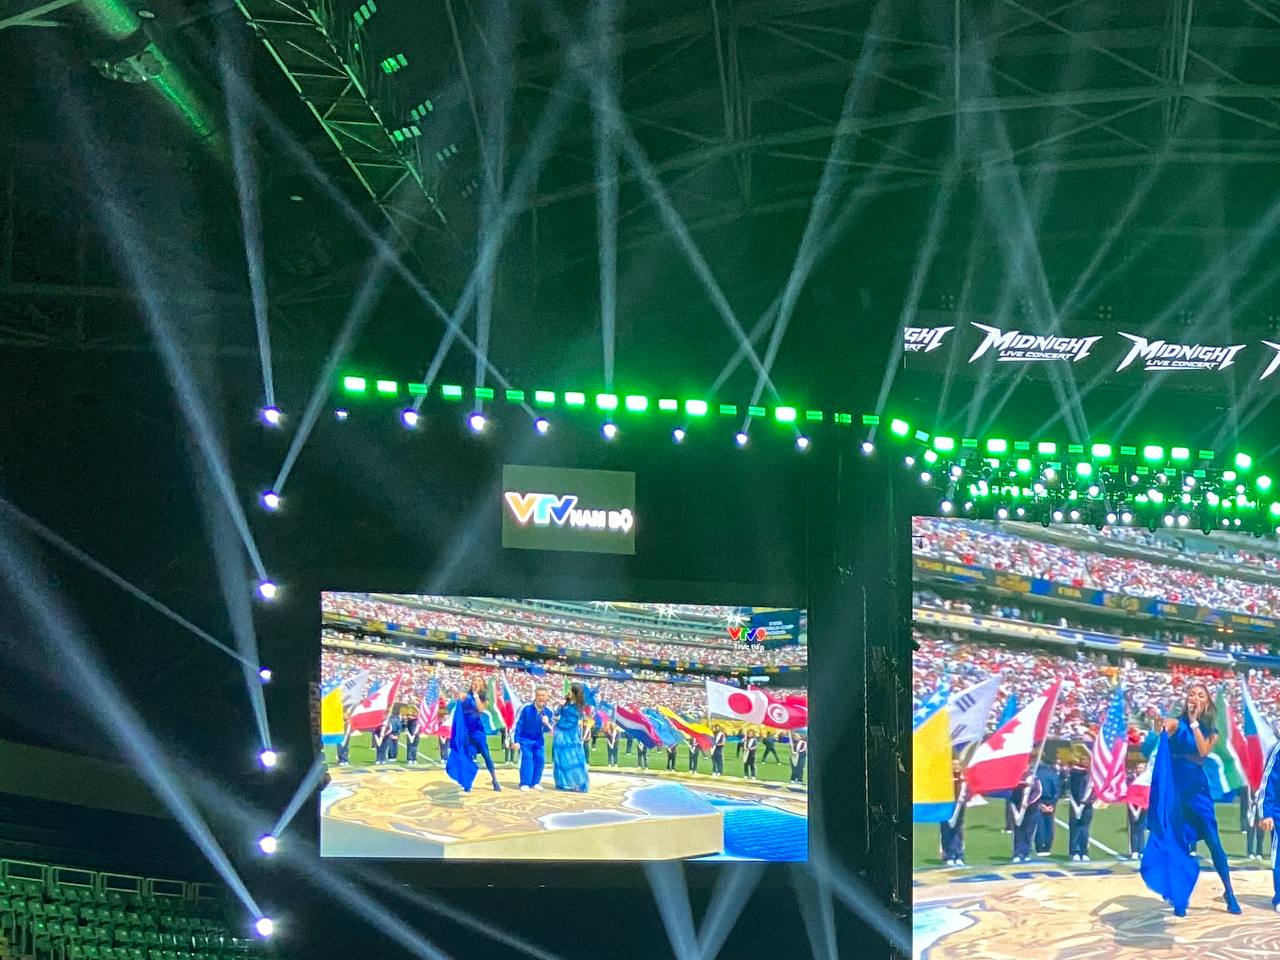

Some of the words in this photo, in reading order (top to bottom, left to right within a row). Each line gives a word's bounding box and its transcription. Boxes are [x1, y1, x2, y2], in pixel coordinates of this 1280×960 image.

[904, 326, 955, 352] GHT
[968, 321, 1103, 363] MIDNIGHT
[1116, 331, 1247, 372] MIDNIGHT
[1024, 352, 1075, 361] CONCERT
[1171, 361, 1219, 370] CONCERT
[504, 491, 579, 525] VTV
[727, 626, 767, 641] VTV9
